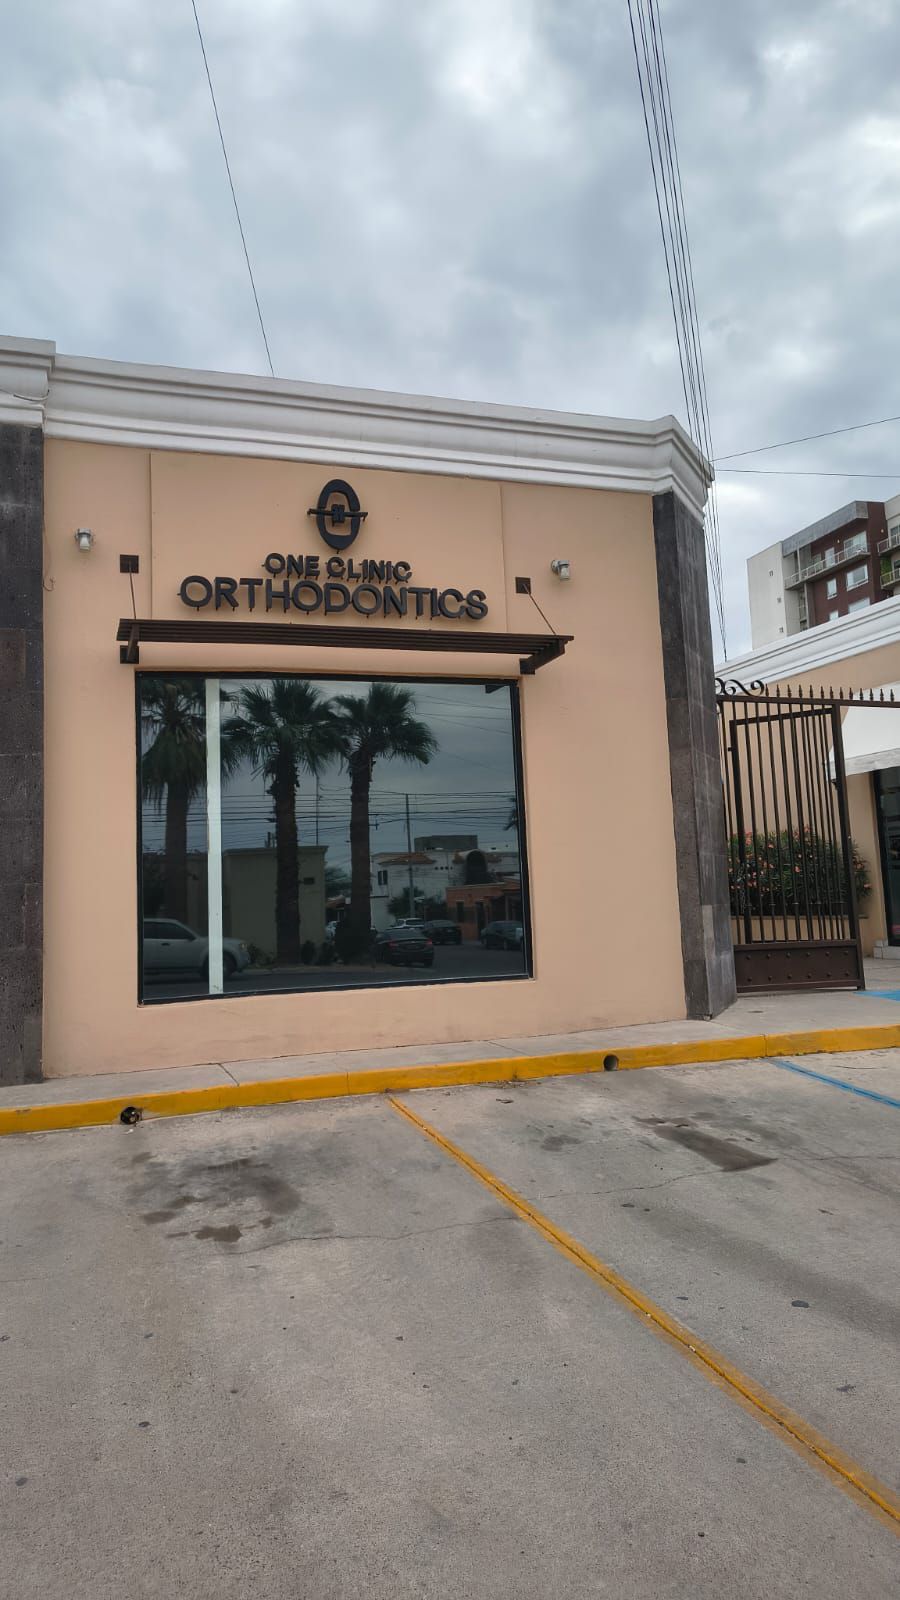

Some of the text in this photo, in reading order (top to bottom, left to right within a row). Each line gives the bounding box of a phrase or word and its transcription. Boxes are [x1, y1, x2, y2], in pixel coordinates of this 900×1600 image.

[264, 552, 412, 581] ONE CLINIC
[180, 575, 488, 619] ORTHODONTICS
